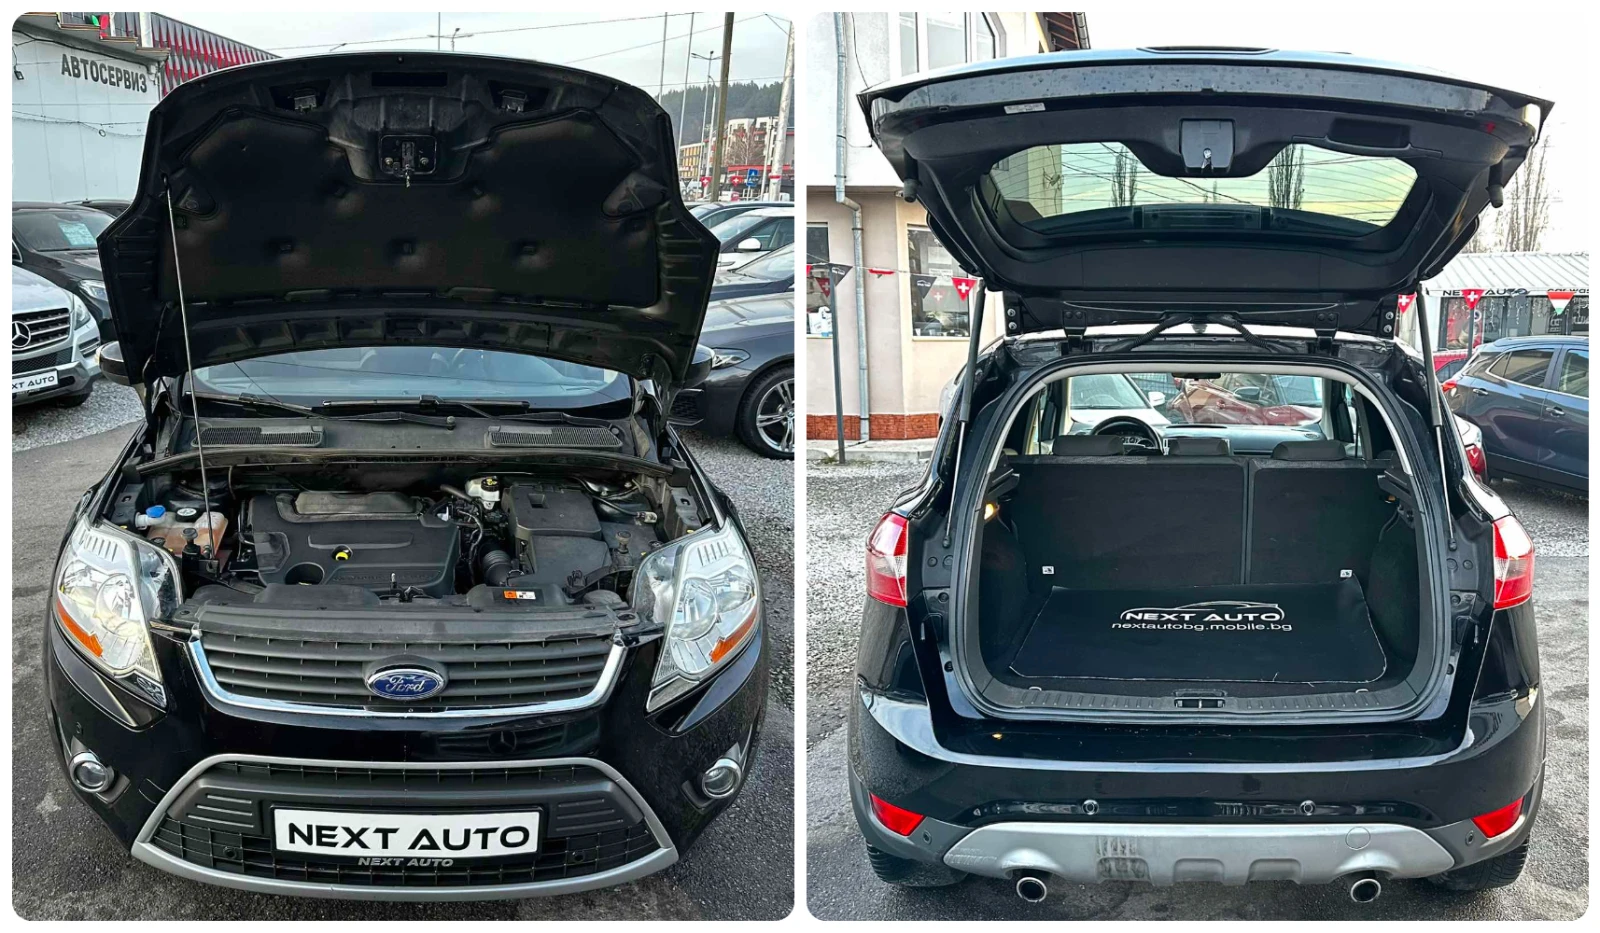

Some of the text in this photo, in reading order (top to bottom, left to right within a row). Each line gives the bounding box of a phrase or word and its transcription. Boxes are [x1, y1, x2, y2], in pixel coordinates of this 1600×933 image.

[61, 53, 148, 93] АВТОСЕРВИЗ
[28, 375, 55, 387] AUTO
[1125, 612, 1281, 621] NEXT AUTO
[1111, 622, 1293, 632] nextautobg.mobile.bg
[385, 675, 425, 692] Ford
[288, 822, 531, 851] NEXT AUTO
[357, 857, 454, 868] NEXT AUTO
